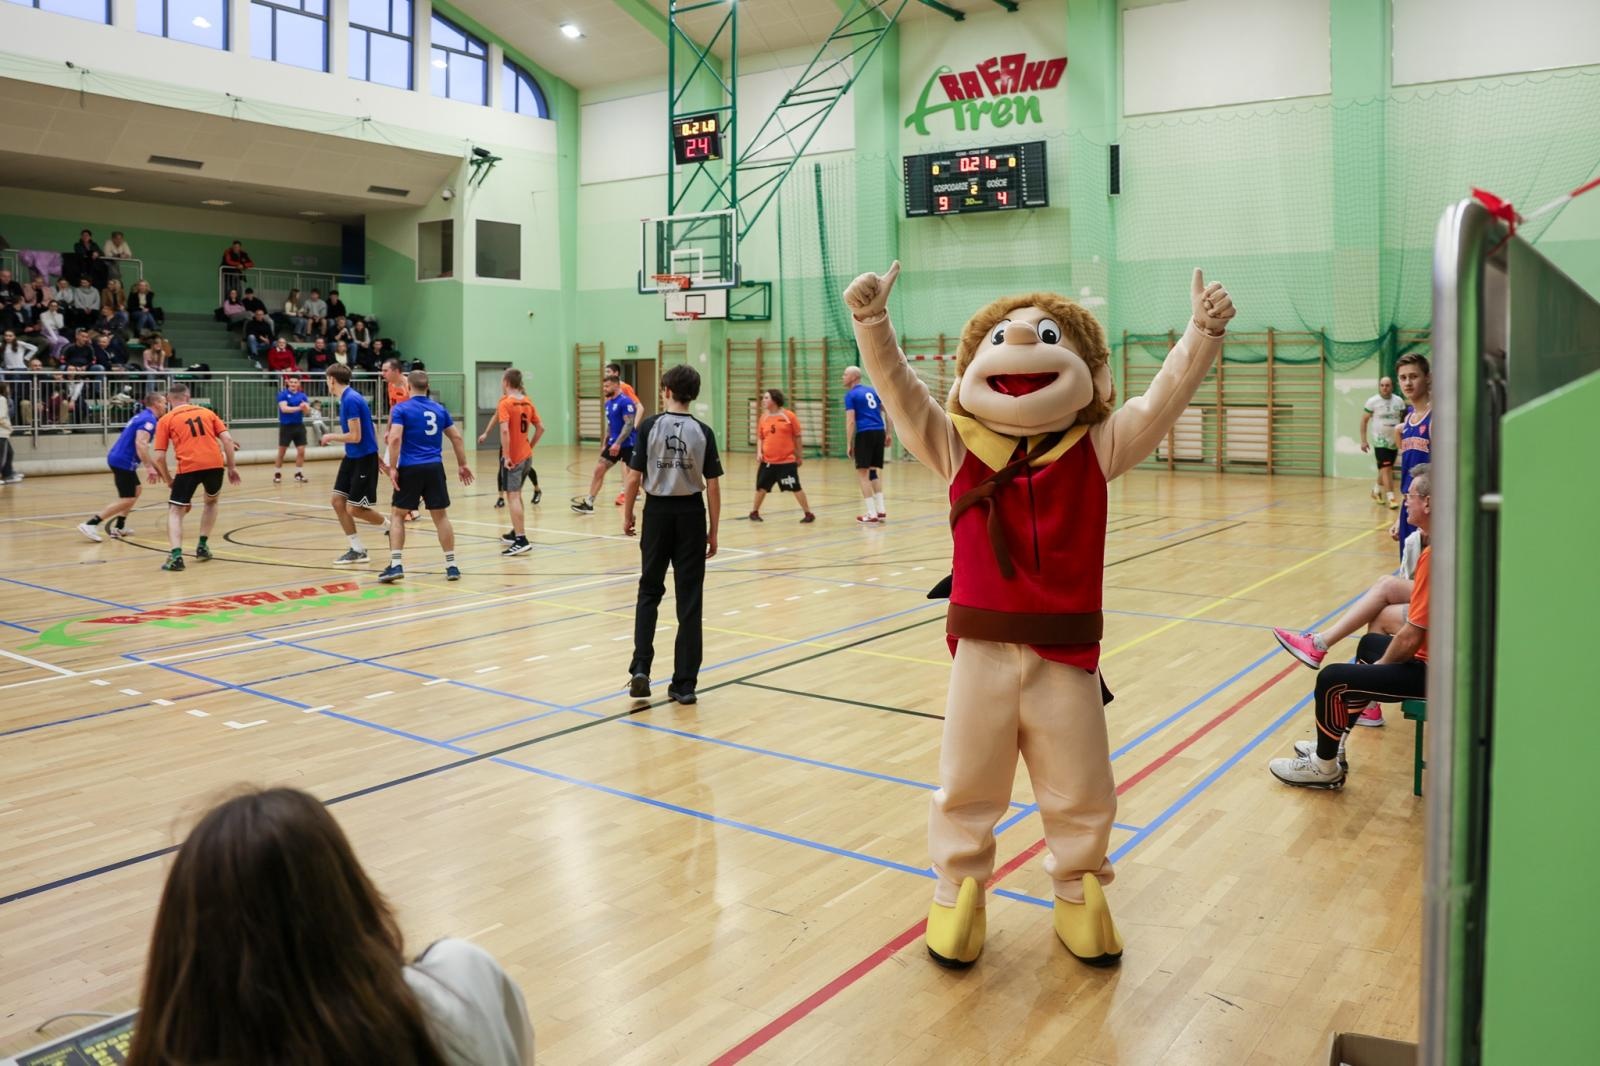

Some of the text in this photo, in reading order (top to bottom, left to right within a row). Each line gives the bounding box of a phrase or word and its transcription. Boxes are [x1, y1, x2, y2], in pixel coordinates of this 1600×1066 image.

[939, 53, 1068, 101] RAFAKO
[686, 137, 708, 157] 24
[939, 196, 949, 210] 9
[997, 191, 1007, 205] 4
[865, 392, 877, 409] 8
[185, 416, 206, 437] 11
[423, 410, 438, 436] 3
[520, 412, 528, 434] 6
